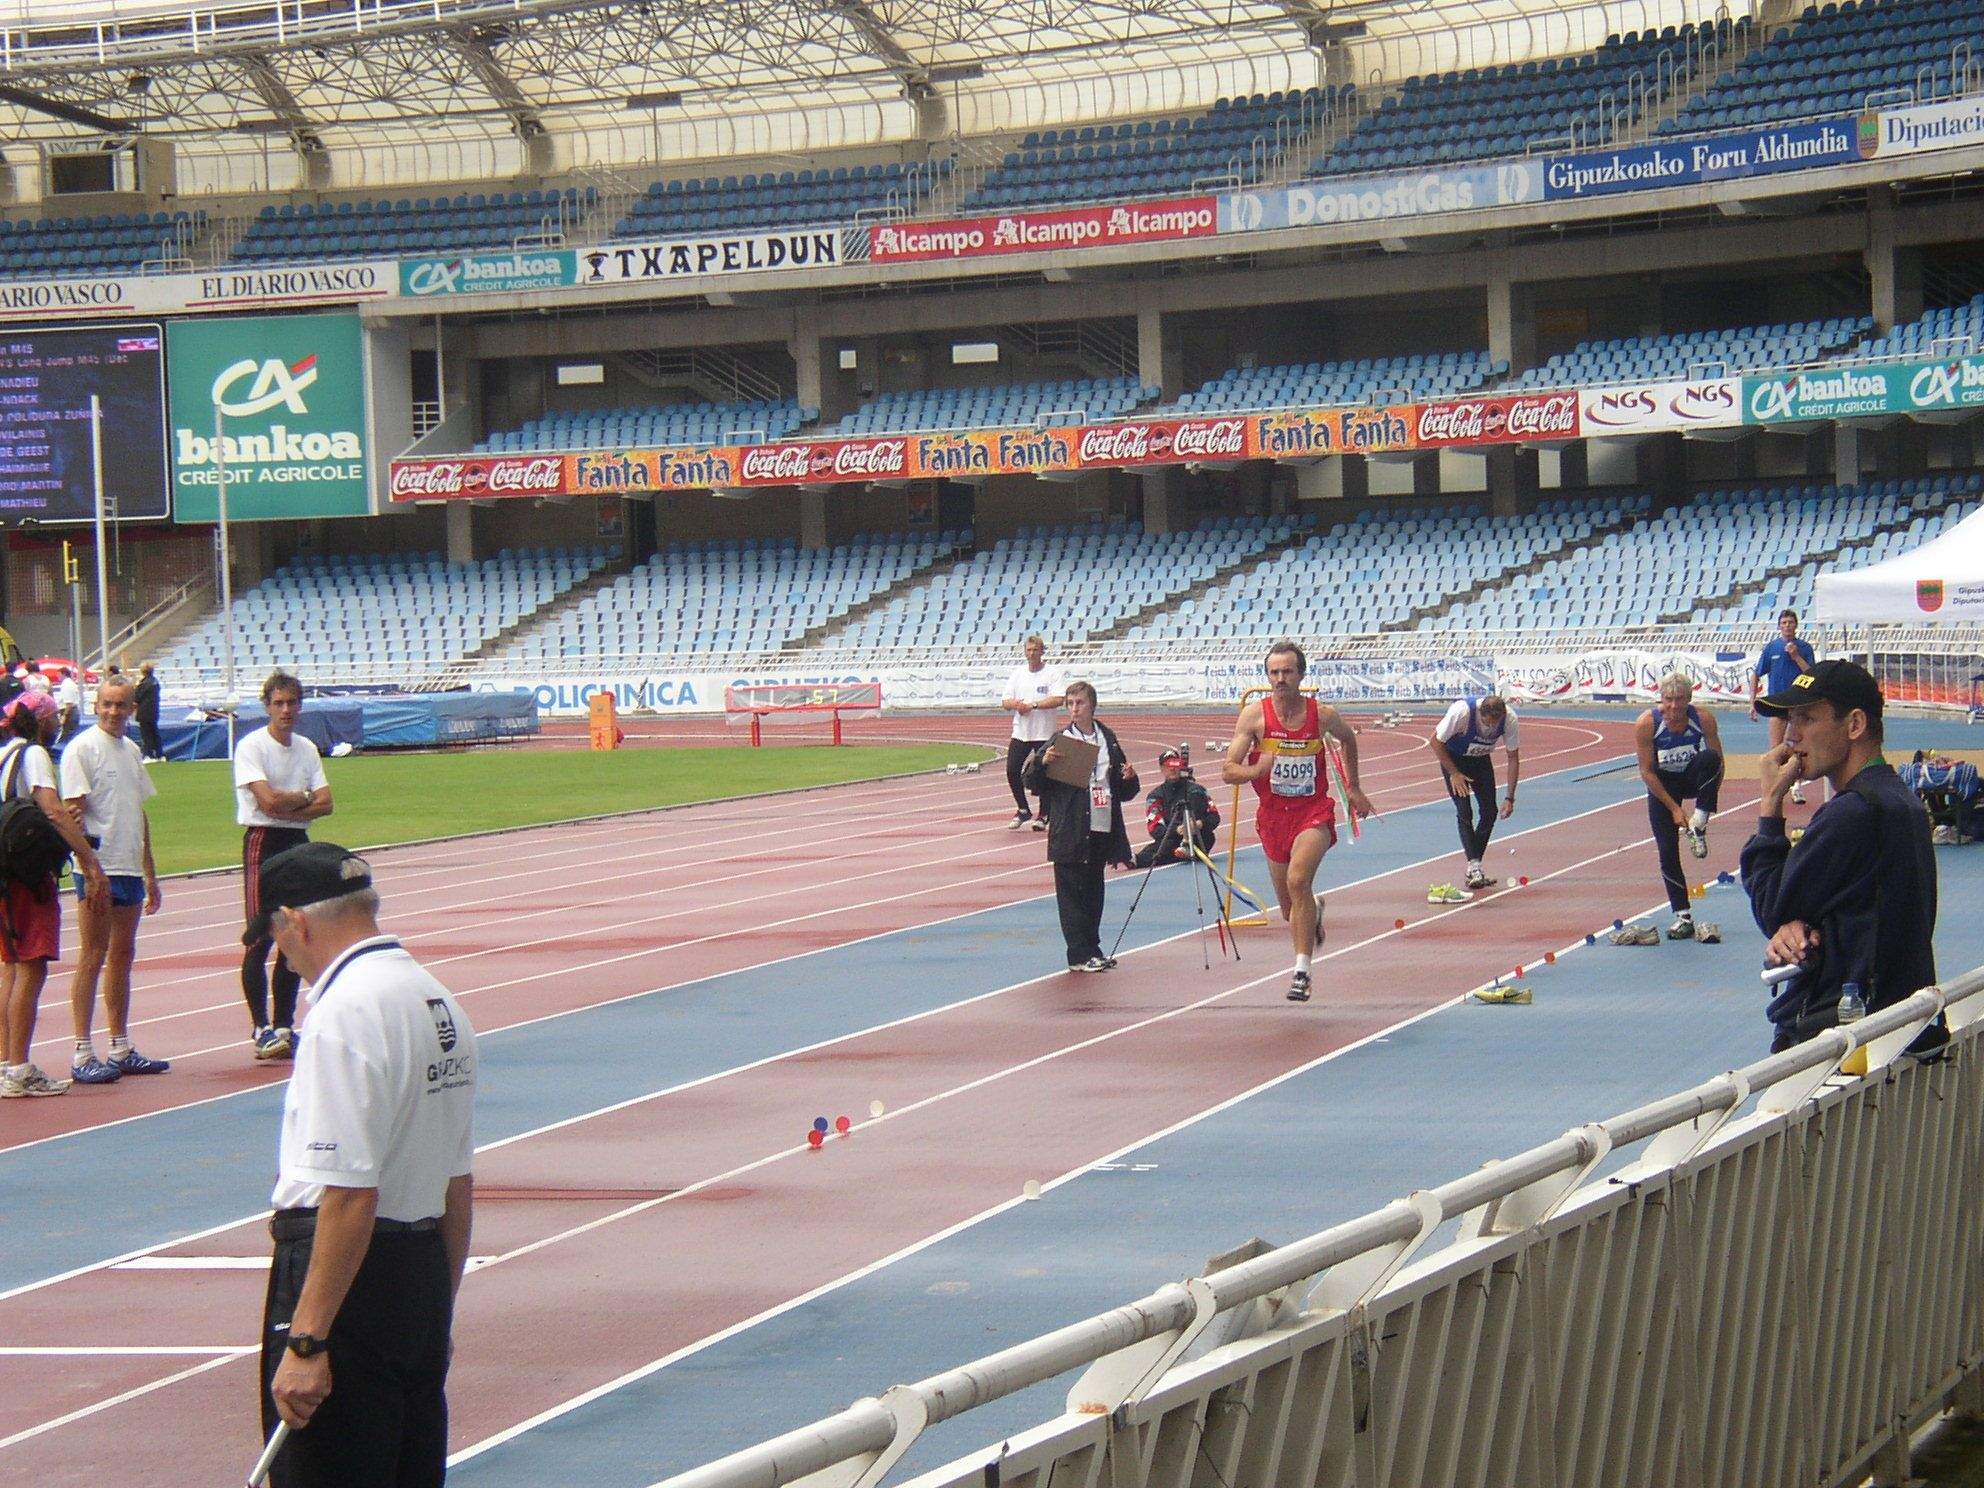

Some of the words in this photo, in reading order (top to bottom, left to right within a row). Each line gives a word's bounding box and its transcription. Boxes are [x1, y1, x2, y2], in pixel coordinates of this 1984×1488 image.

[1548, 154, 1684, 192] Gipuzkoako
[1691, 142, 1747, 172] Foru
[1753, 124, 1850, 164] Aldundia
[875, 228, 984, 256] Alcampo
[993, 217, 1101, 247] Alcampo
[1106, 206, 1213, 237] Alcampo
[464, 255, 562, 278] bankoa
[614, 232, 837, 279] TXAPELDUN
[54, 282, 123, 306] VASCO
[202, 278, 227, 299] EL
[228, 272, 308, 297] DIARIO
[310, 267, 375, 291] VASCO
[1601, 389, 1657, 417] NGS
[1684, 383, 1732, 409] NGS
[1798, 371, 1887, 401] bankoa
[1508, 397, 1576, 434] Coca-Cola
[1835, 398, 1887, 413] AGRICOLE
[1173, 420, 1245, 456] Coca-Cola
[1259, 415, 1330, 453] Fanta
[1340, 411, 1410, 450] Fanta
[1418, 404, 1484, 442] Coca-Cola
[177, 424, 363, 465] bankoa
[834, 442, 904, 475] Coca-Cola
[919, 438, 989, 472] Fanta
[999, 434, 1069, 469] Fanta
[1080, 427, 1149, 462] Coca-Cola
[258, 464, 363, 483] AGRICOLE
[392, 463, 468, 496] Coca-Cola
[493, 459, 567, 492] Coca-Cola
[576, 456, 650, 489] Fanta
[659, 453, 731, 485] Fanta
[742, 448, 811, 481] Coca-Cola
[1273, 762, 1313, 779] 45099
